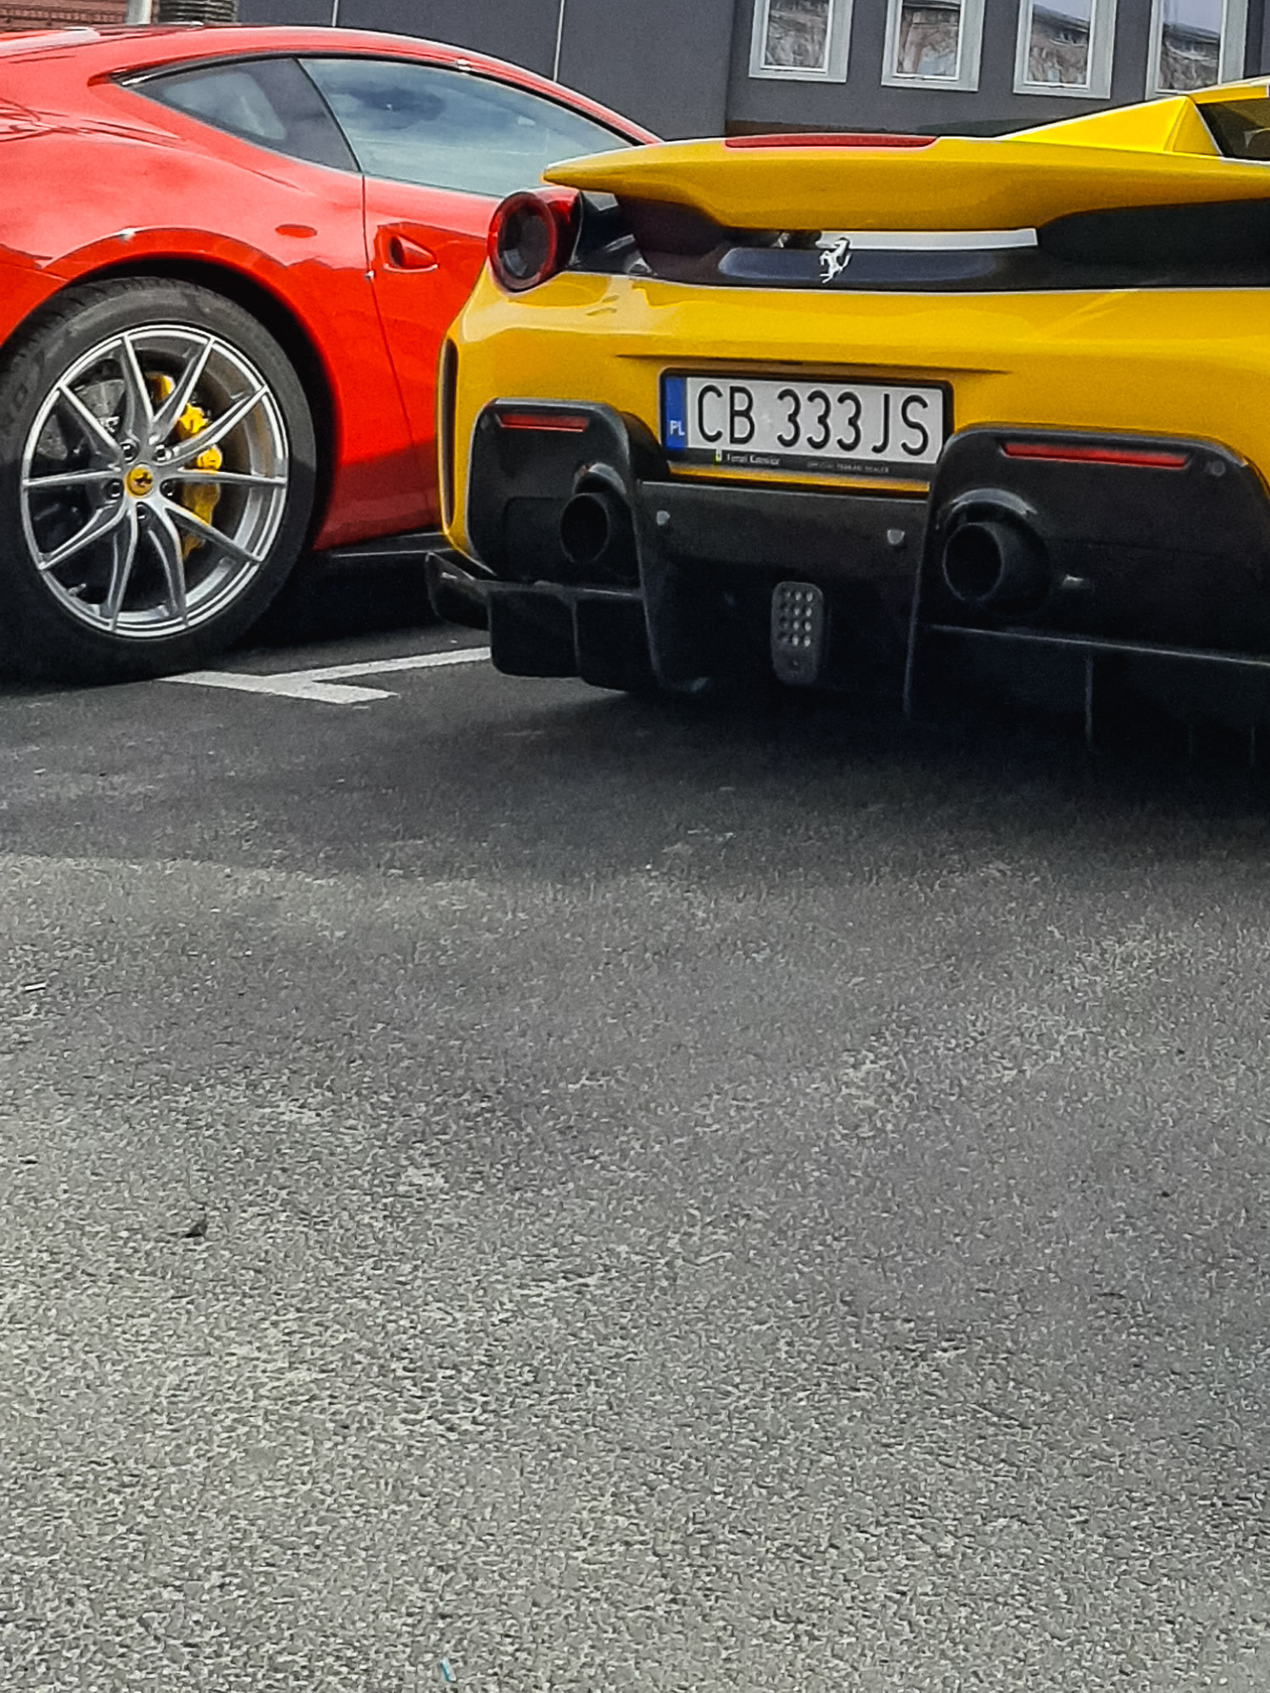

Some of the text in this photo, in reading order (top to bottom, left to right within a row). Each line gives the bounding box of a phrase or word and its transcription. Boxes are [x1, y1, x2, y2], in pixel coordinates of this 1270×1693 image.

[669, 420, 685, 436] PL
[698, 385, 930, 456] CB 333JS
